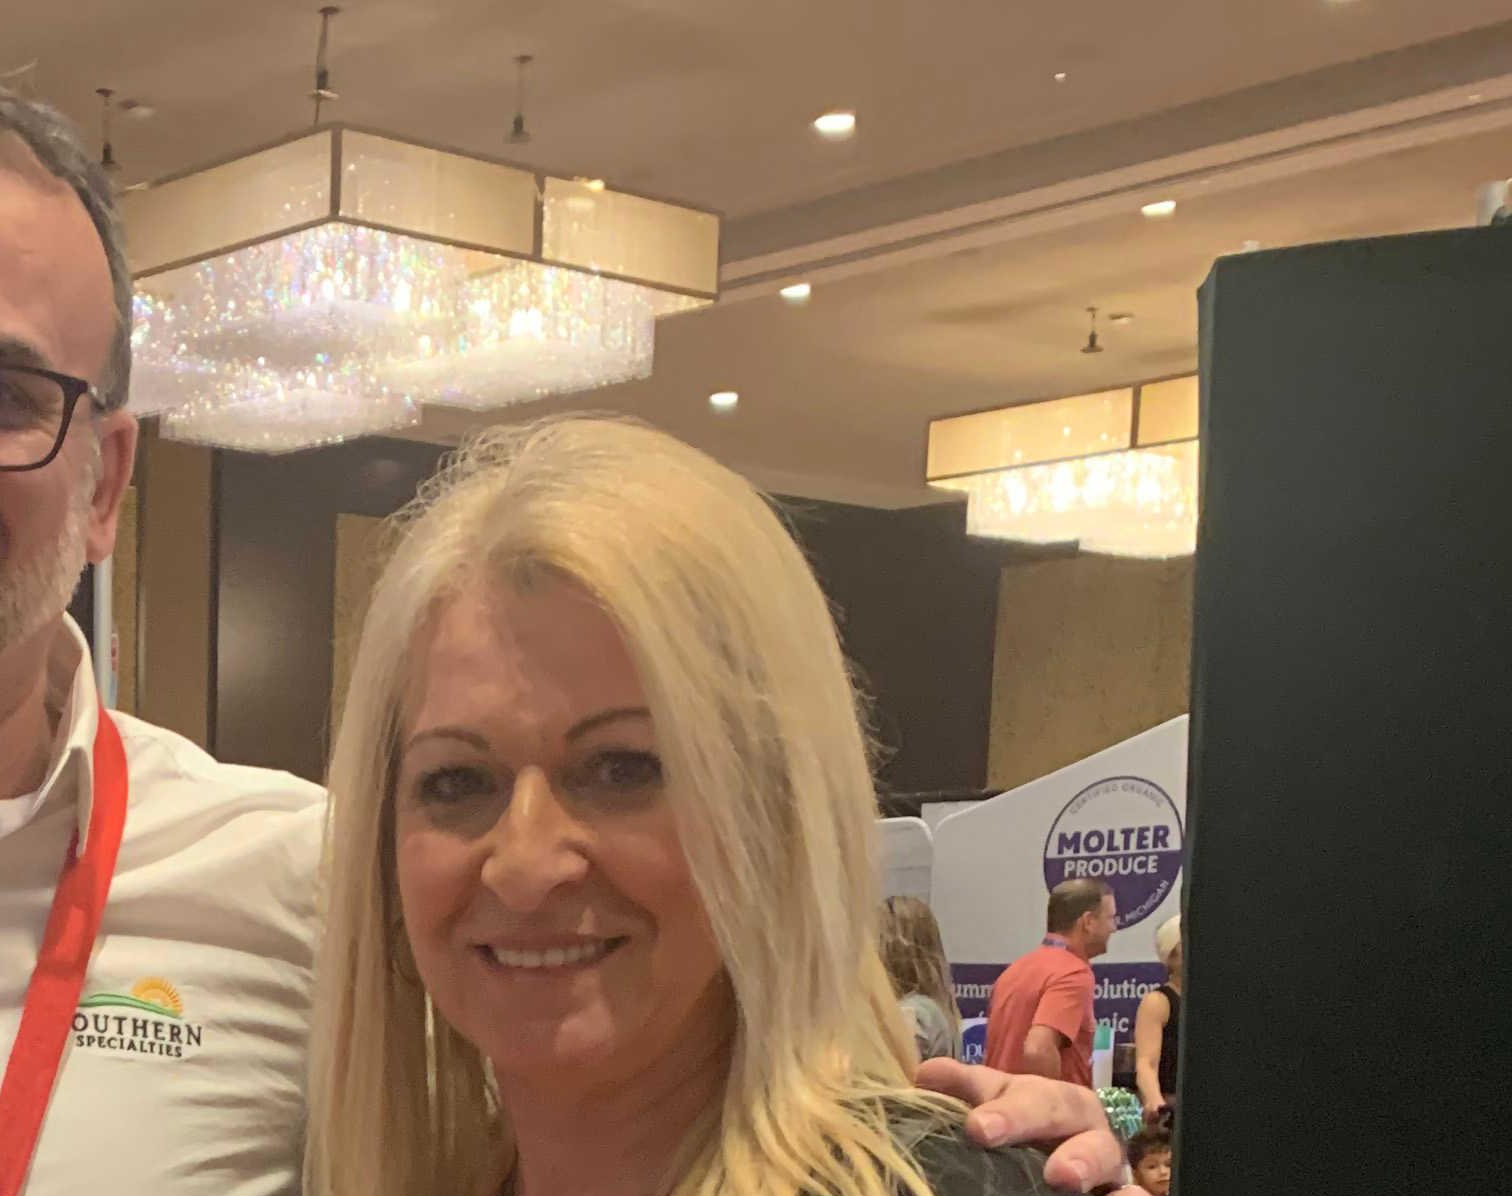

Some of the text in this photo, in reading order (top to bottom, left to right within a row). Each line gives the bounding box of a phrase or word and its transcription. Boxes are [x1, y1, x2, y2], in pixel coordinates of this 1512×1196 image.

[1057, 825, 1170, 855] MOLTER
[1064, 855, 1159, 877] PRODUCE
[72, 1013, 202, 1046] OUTHERN
[76, 1035, 182, 1058] SPECIALTIES
